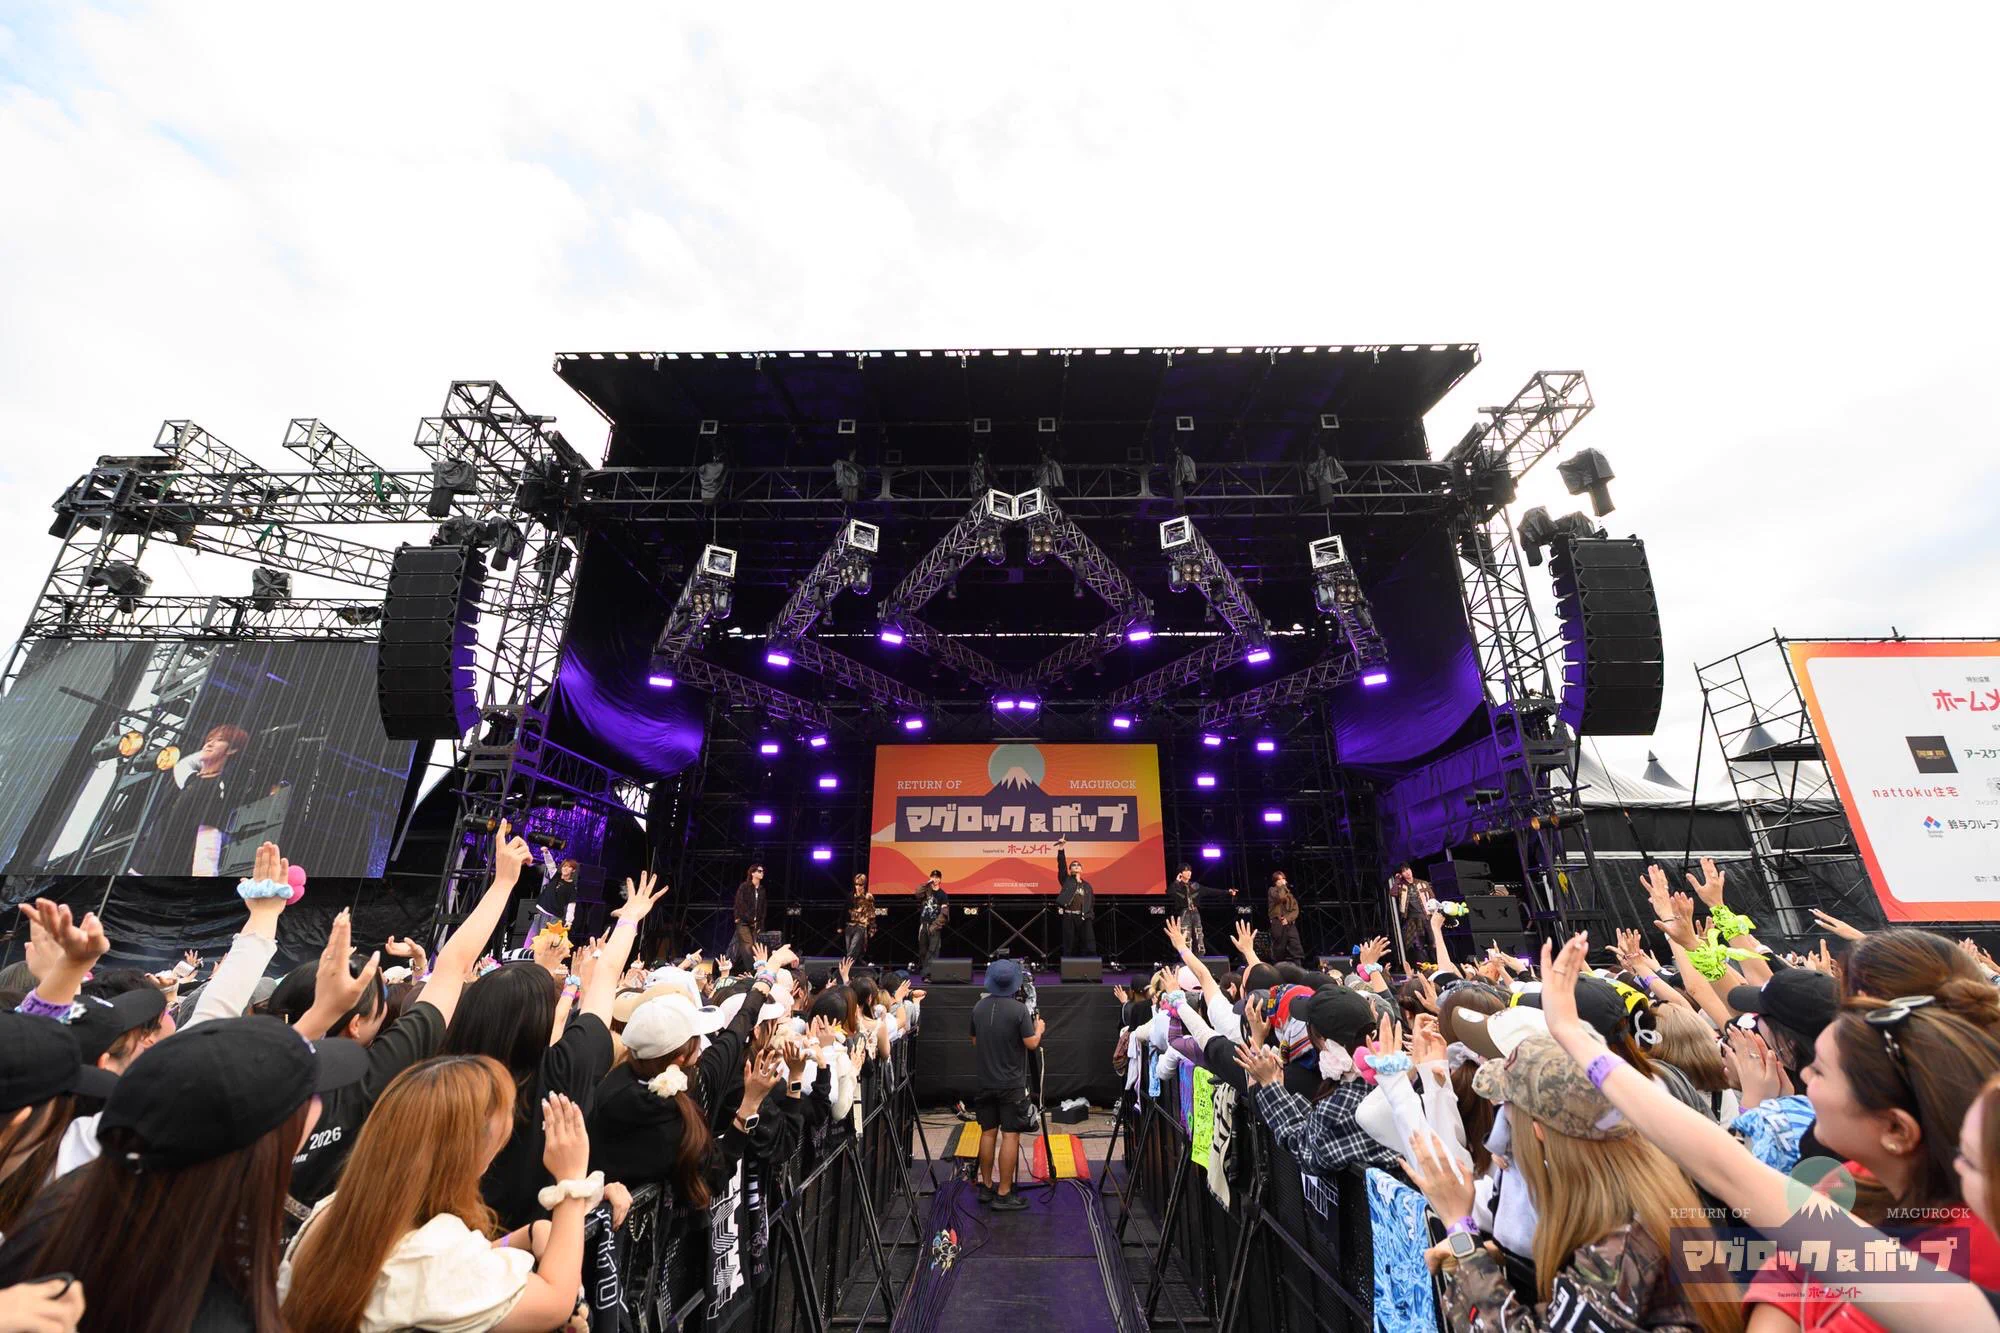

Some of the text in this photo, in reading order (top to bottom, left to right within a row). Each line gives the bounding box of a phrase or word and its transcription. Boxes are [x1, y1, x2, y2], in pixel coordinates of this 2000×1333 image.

[1963, 748, 2000, 759] アースケ
[897, 779, 962, 791] RETURN OF
[1069, 779, 1137, 791] MAGUROCK
[1872, 786, 1960, 798] nattoku住宅
[1007, 844, 1051, 855] ホームメイト
[309, 1126, 342, 1151] 2026
